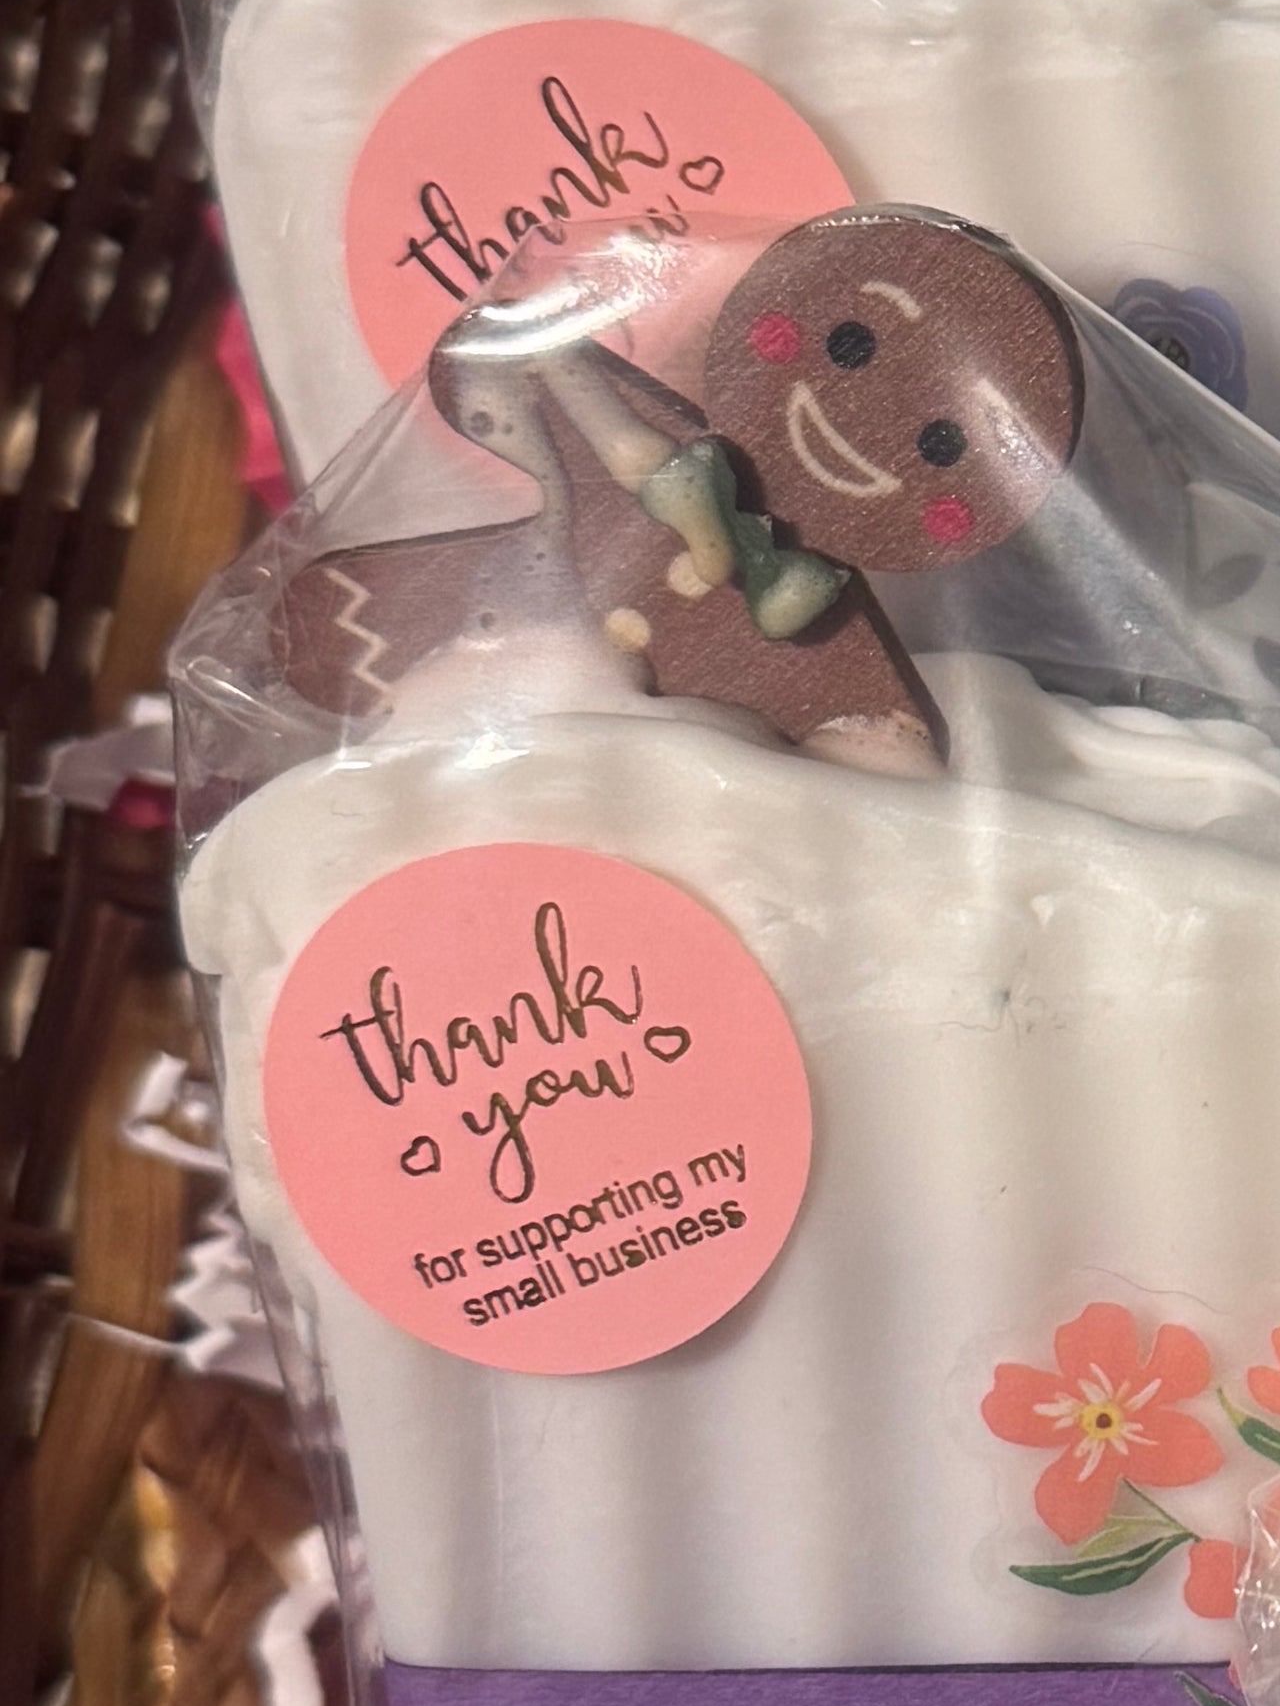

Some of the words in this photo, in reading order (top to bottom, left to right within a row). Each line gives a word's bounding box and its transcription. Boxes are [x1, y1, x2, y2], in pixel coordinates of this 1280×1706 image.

[396, 76, 669, 302] thank
[319, 901, 643, 1107] thank
[461, 1050, 635, 1204] you
[412, 1246, 468, 1290] for
[476, 1169, 684, 1268] supporting
[687, 1143, 748, 1189] my
[462, 1259, 565, 1327] small
[566, 1199, 748, 1288] business
